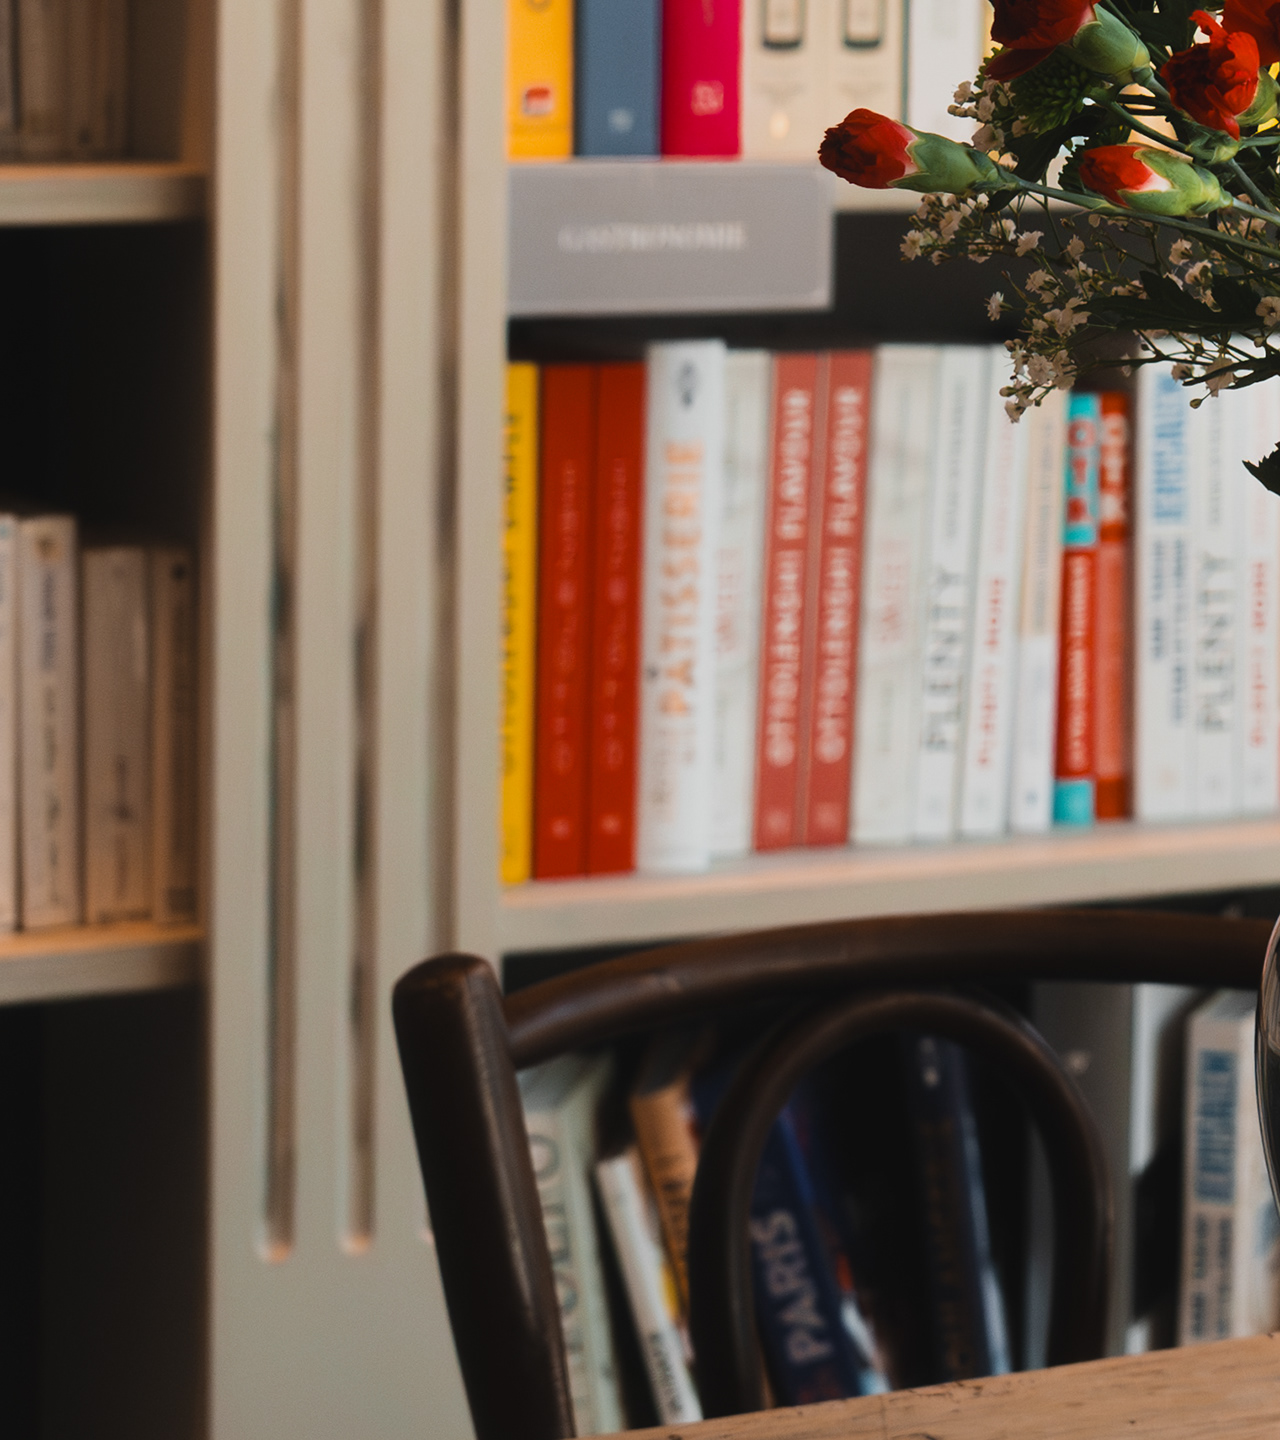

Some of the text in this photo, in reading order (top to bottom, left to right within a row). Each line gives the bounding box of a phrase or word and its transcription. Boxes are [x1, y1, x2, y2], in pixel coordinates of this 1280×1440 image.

[558, 221, 747, 253] GASTRONOMIE
[650, 439, 704, 718] PÂTISSERIE
[766, 389, 811, 768] OTTOLENGHI FLAVOUR
[817, 388, 863, 765] OTTOLENGHI FLAVOUR
[922, 563, 966, 752] PLENTY
[1196, 552, 1236, 734] PLENTY
[752, 1208, 834, 1369] PARIS
